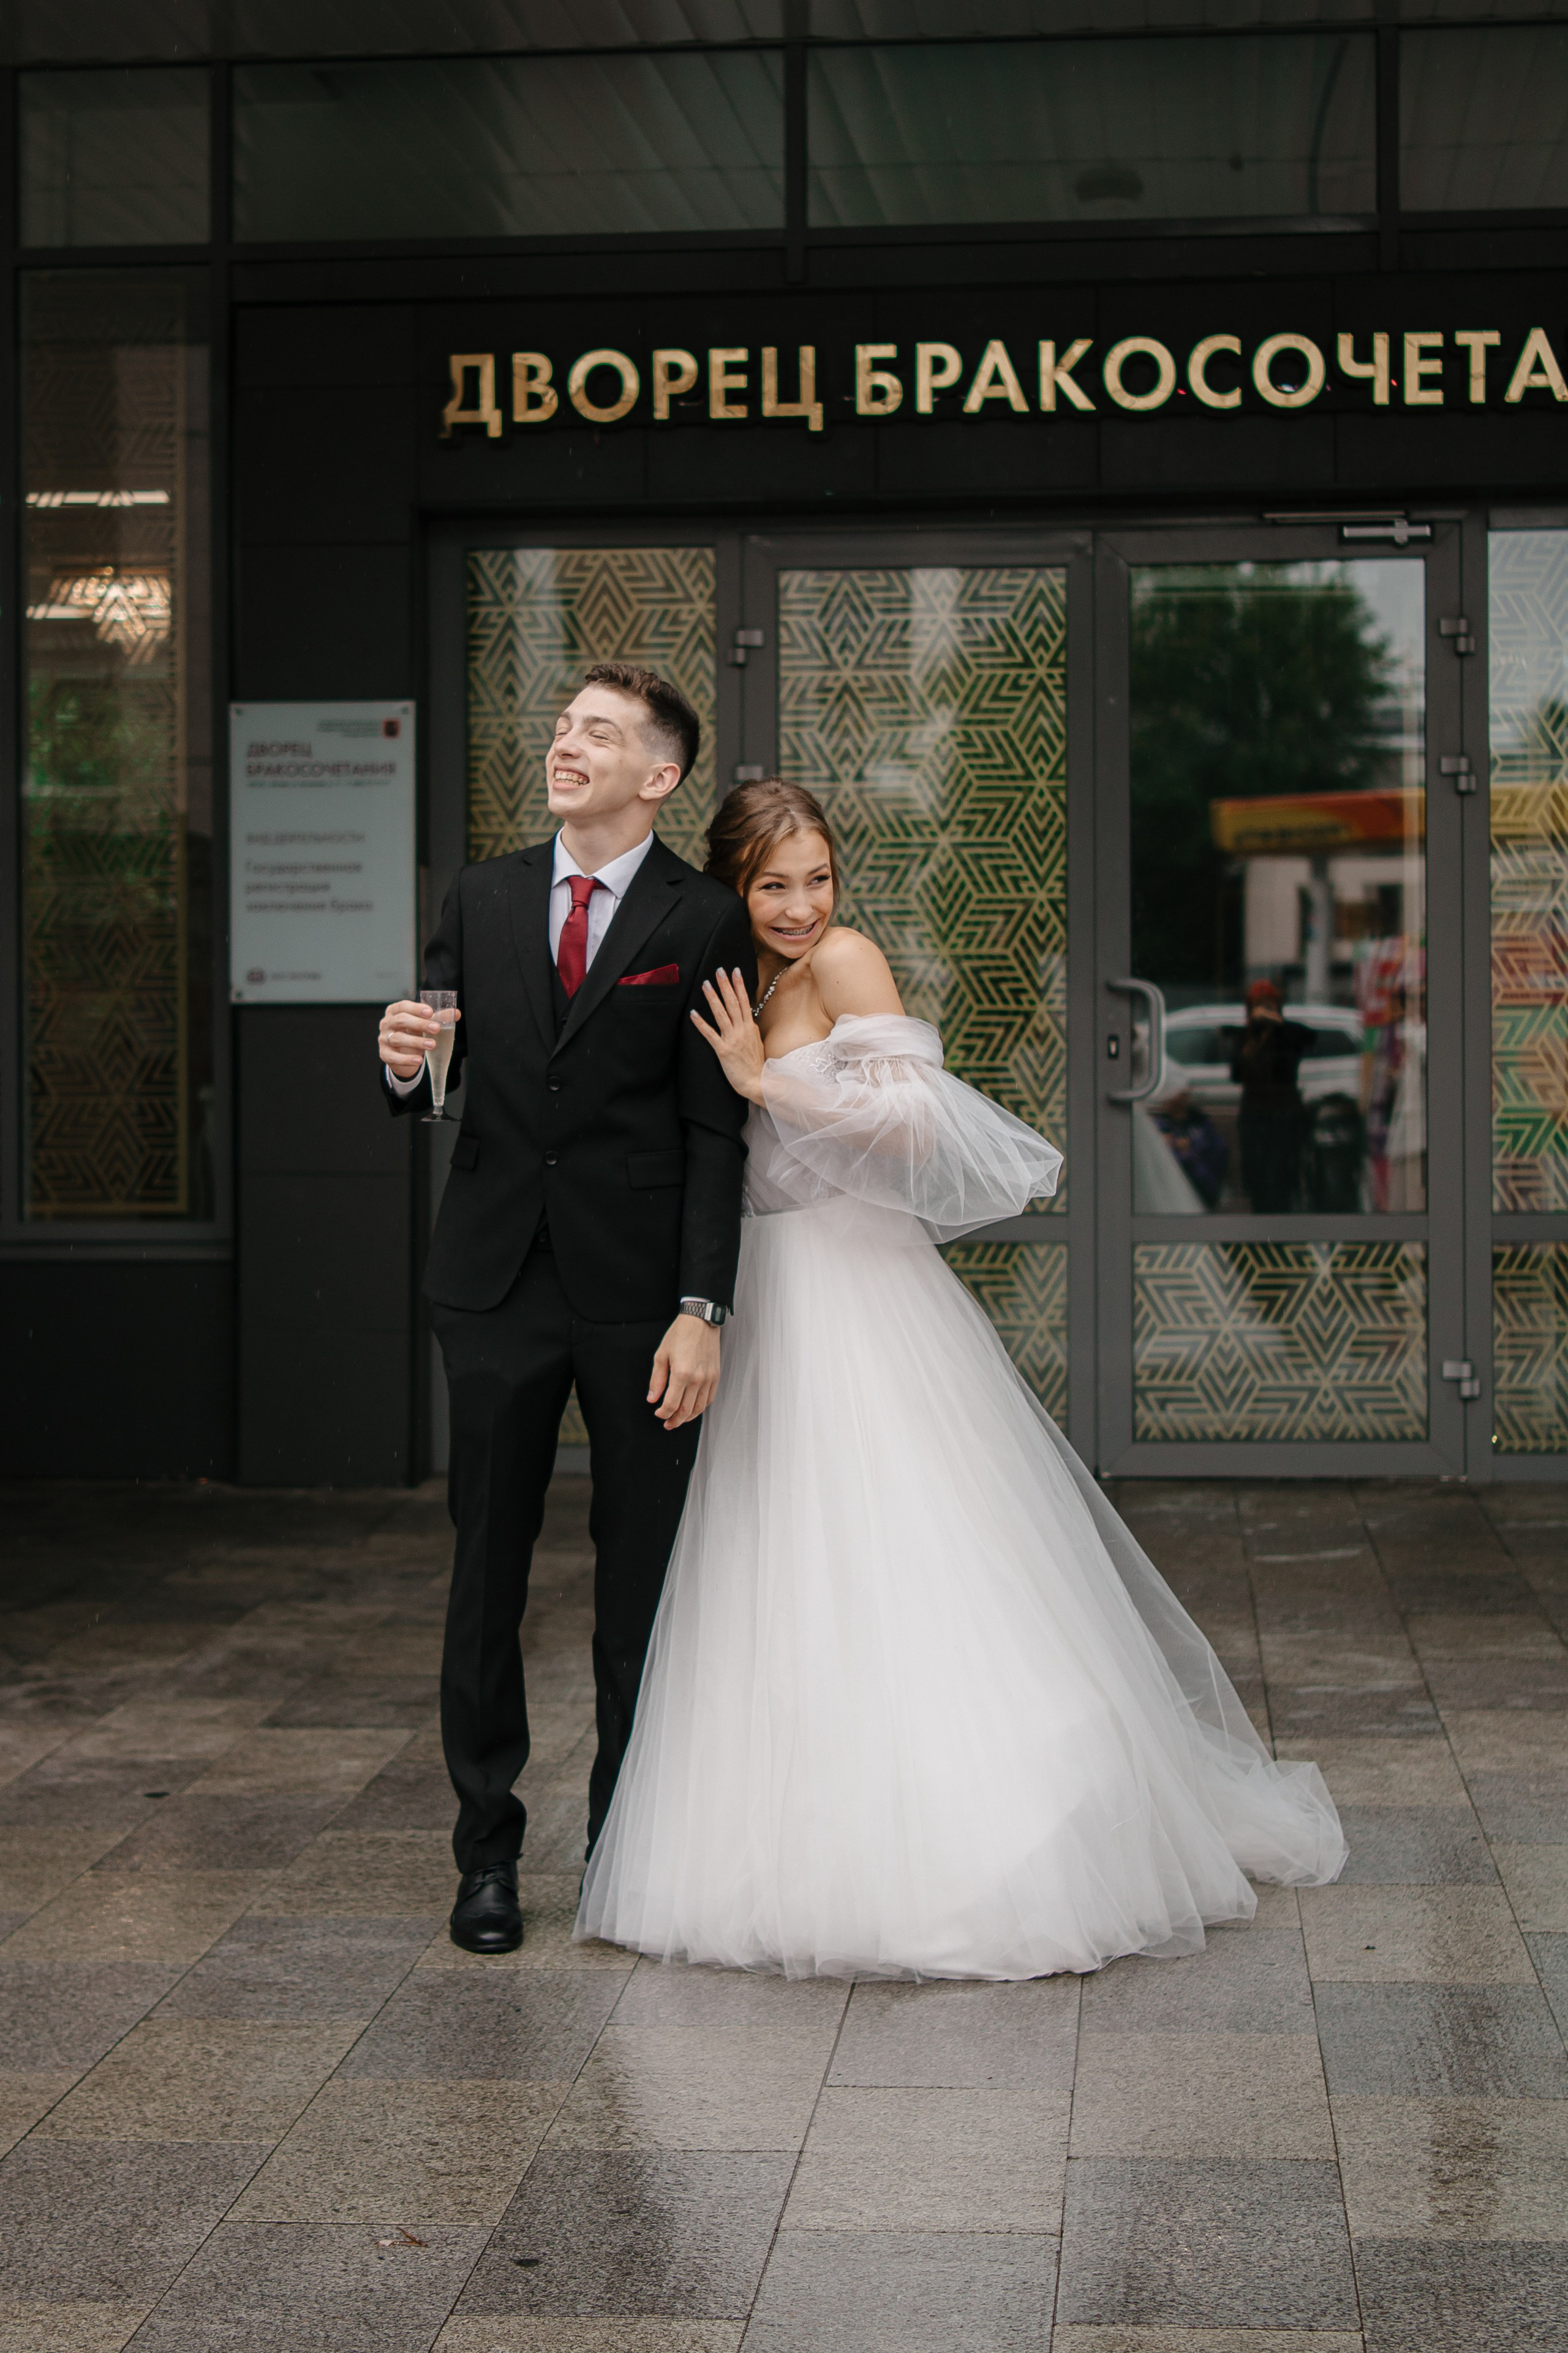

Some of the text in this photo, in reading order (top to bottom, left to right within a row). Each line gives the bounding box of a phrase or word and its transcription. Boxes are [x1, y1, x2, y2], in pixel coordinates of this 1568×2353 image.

[439, 327, 1568, 439] ДВОРЕЦ БРАКОСОЧЕТА
[247, 741, 312, 757] ДВОРЕЦ
[246, 761, 396, 777] БРАКОСОЧЕТАНИЯ
